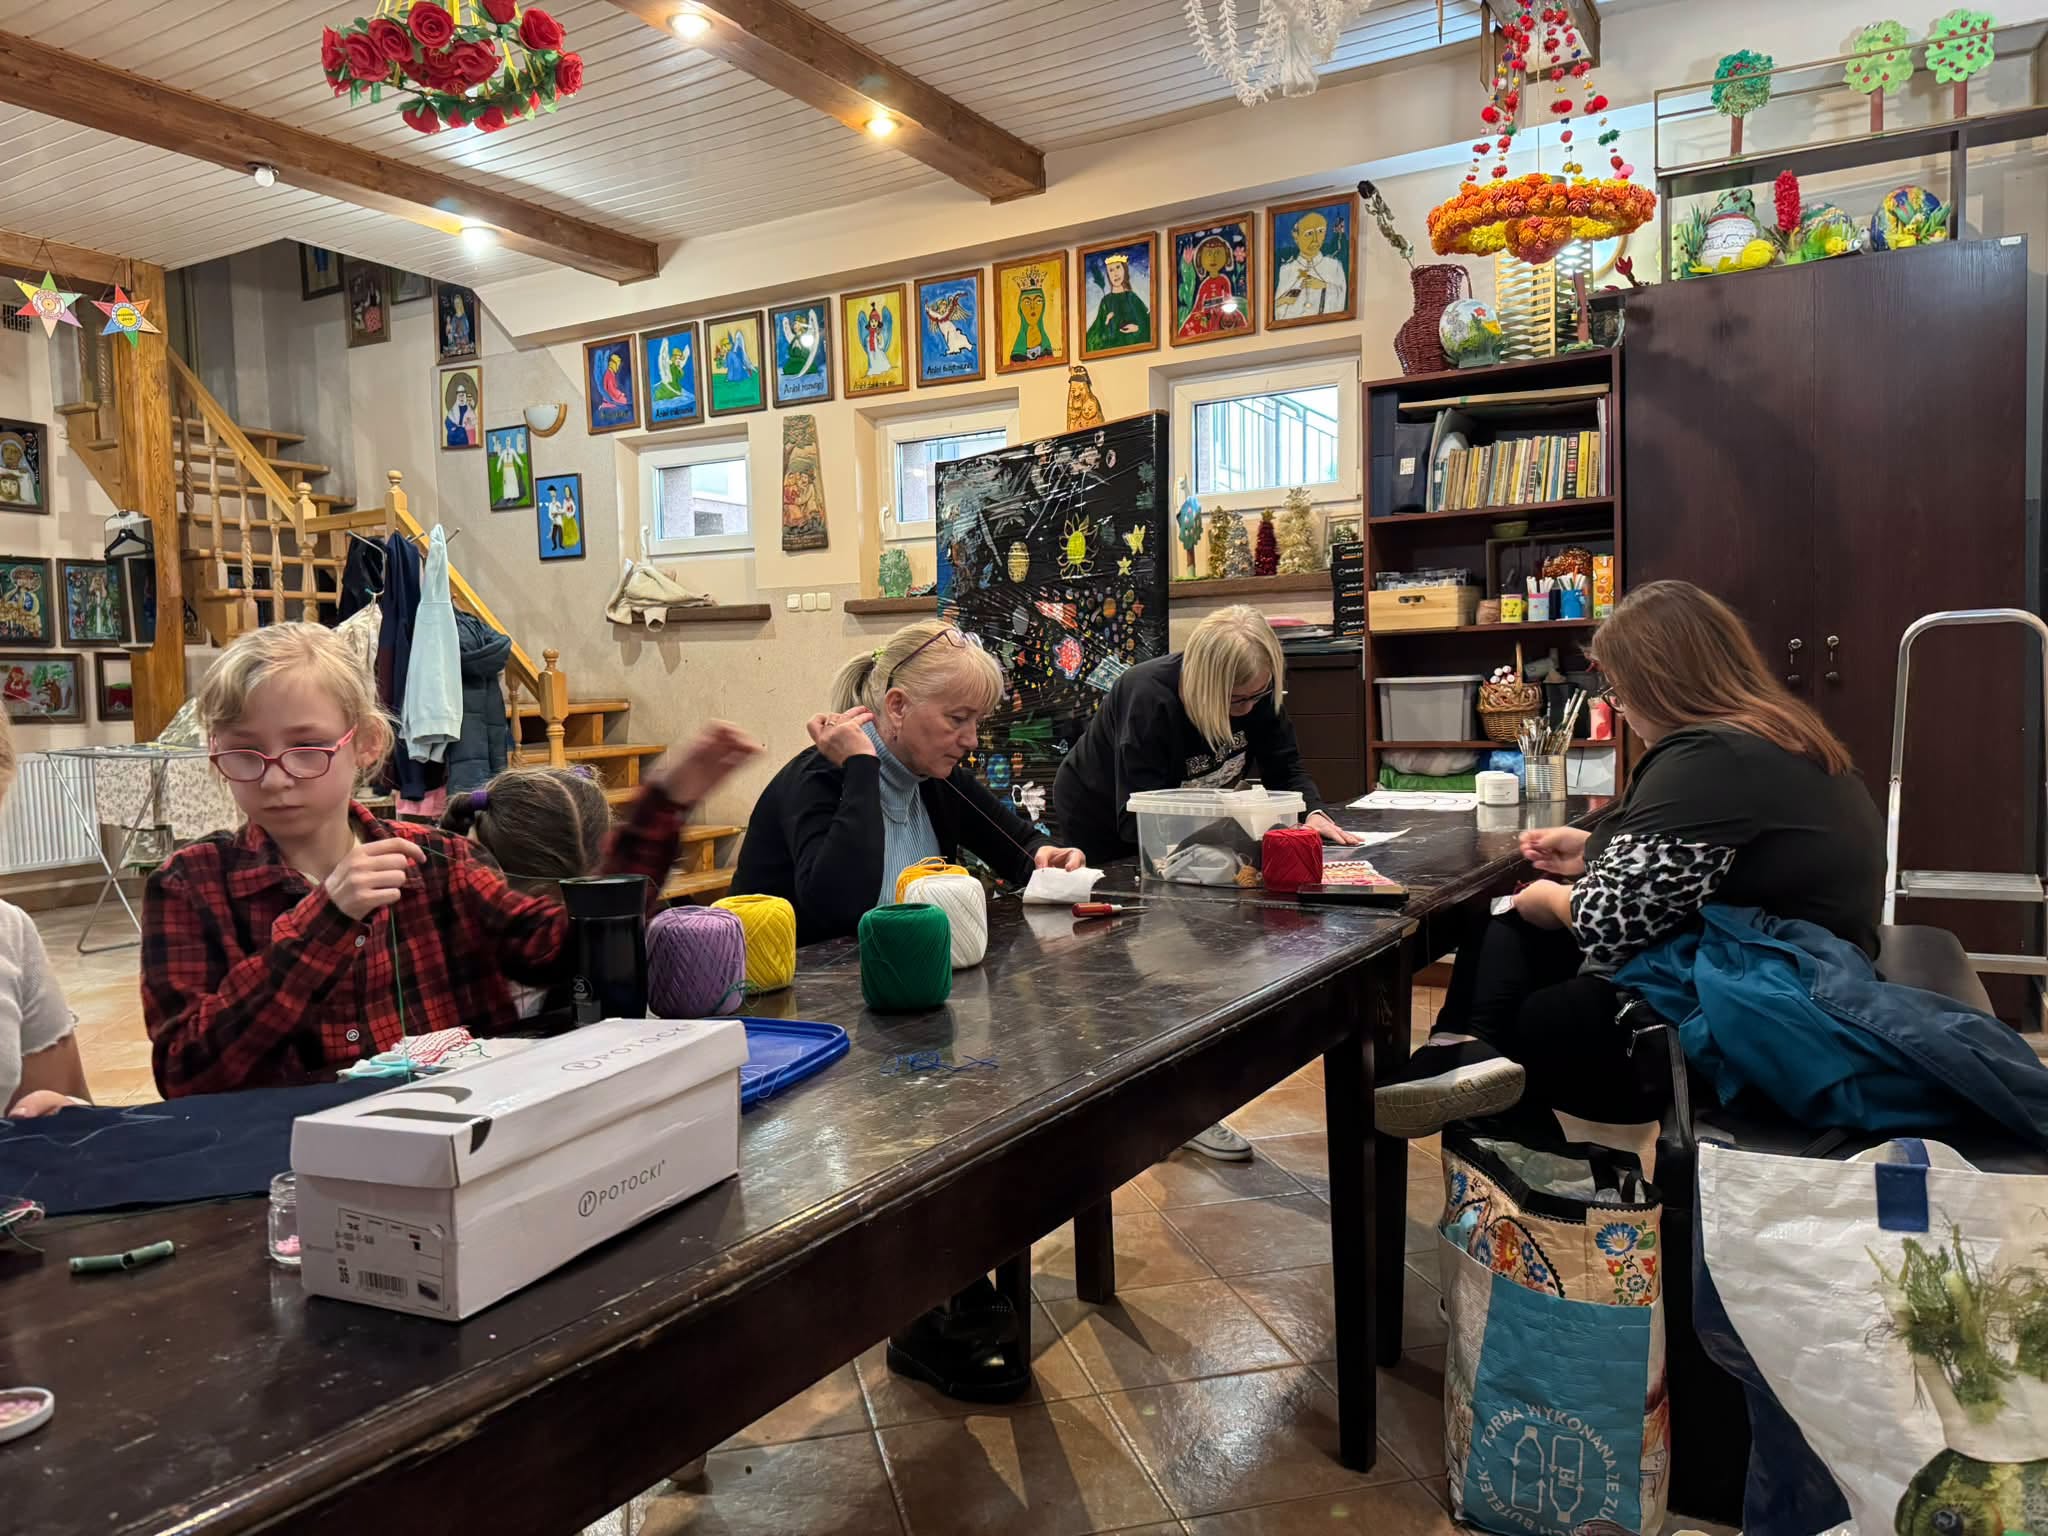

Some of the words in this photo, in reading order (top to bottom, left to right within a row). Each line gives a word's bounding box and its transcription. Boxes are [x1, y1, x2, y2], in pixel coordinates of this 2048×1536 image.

[599, 1161, 662, 1206] POTOCKI
[1480, 1405, 1525, 1447] TORBA
[1525, 1403, 1617, 1471] WYKONANA
[1477, 1468, 1535, 1530] BUTELEK
